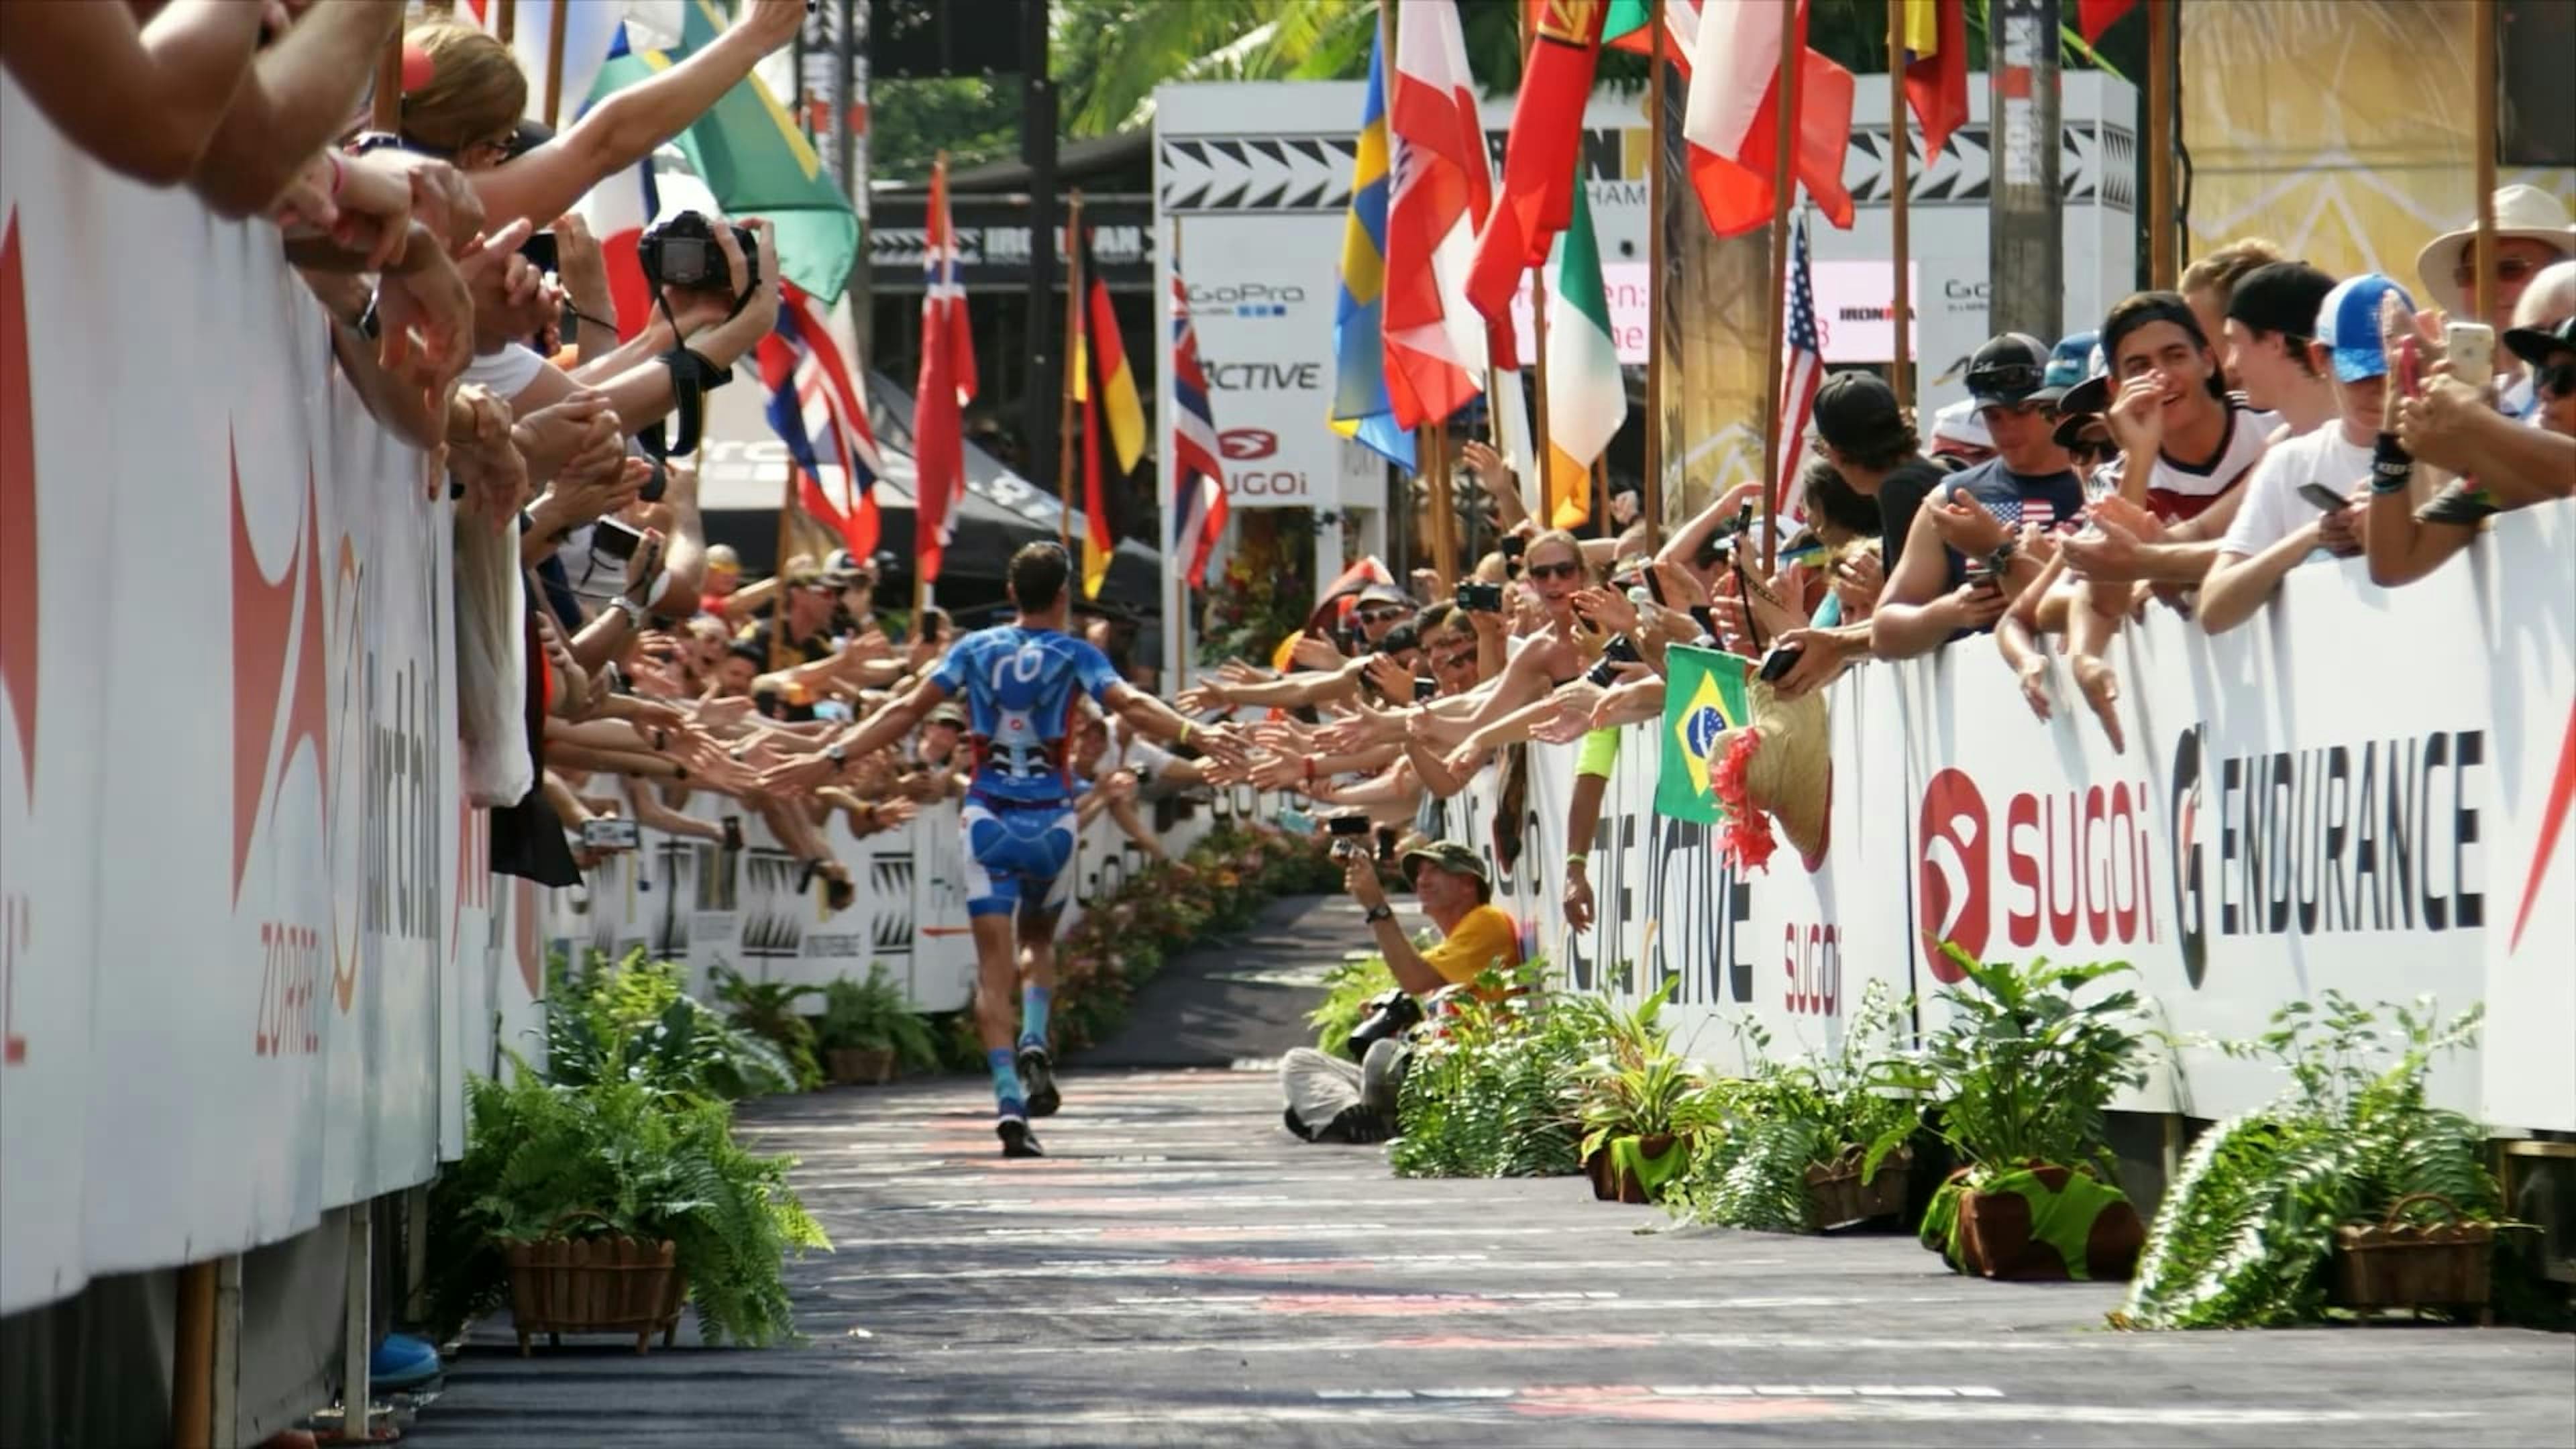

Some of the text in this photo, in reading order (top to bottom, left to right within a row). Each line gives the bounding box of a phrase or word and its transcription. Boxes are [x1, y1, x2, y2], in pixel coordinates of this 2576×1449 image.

[1188, 284, 1305, 302] GoPro
[1225, 471, 1307, 495] UGOi
[2222, 729, 2485, 936] ENDURANCE
